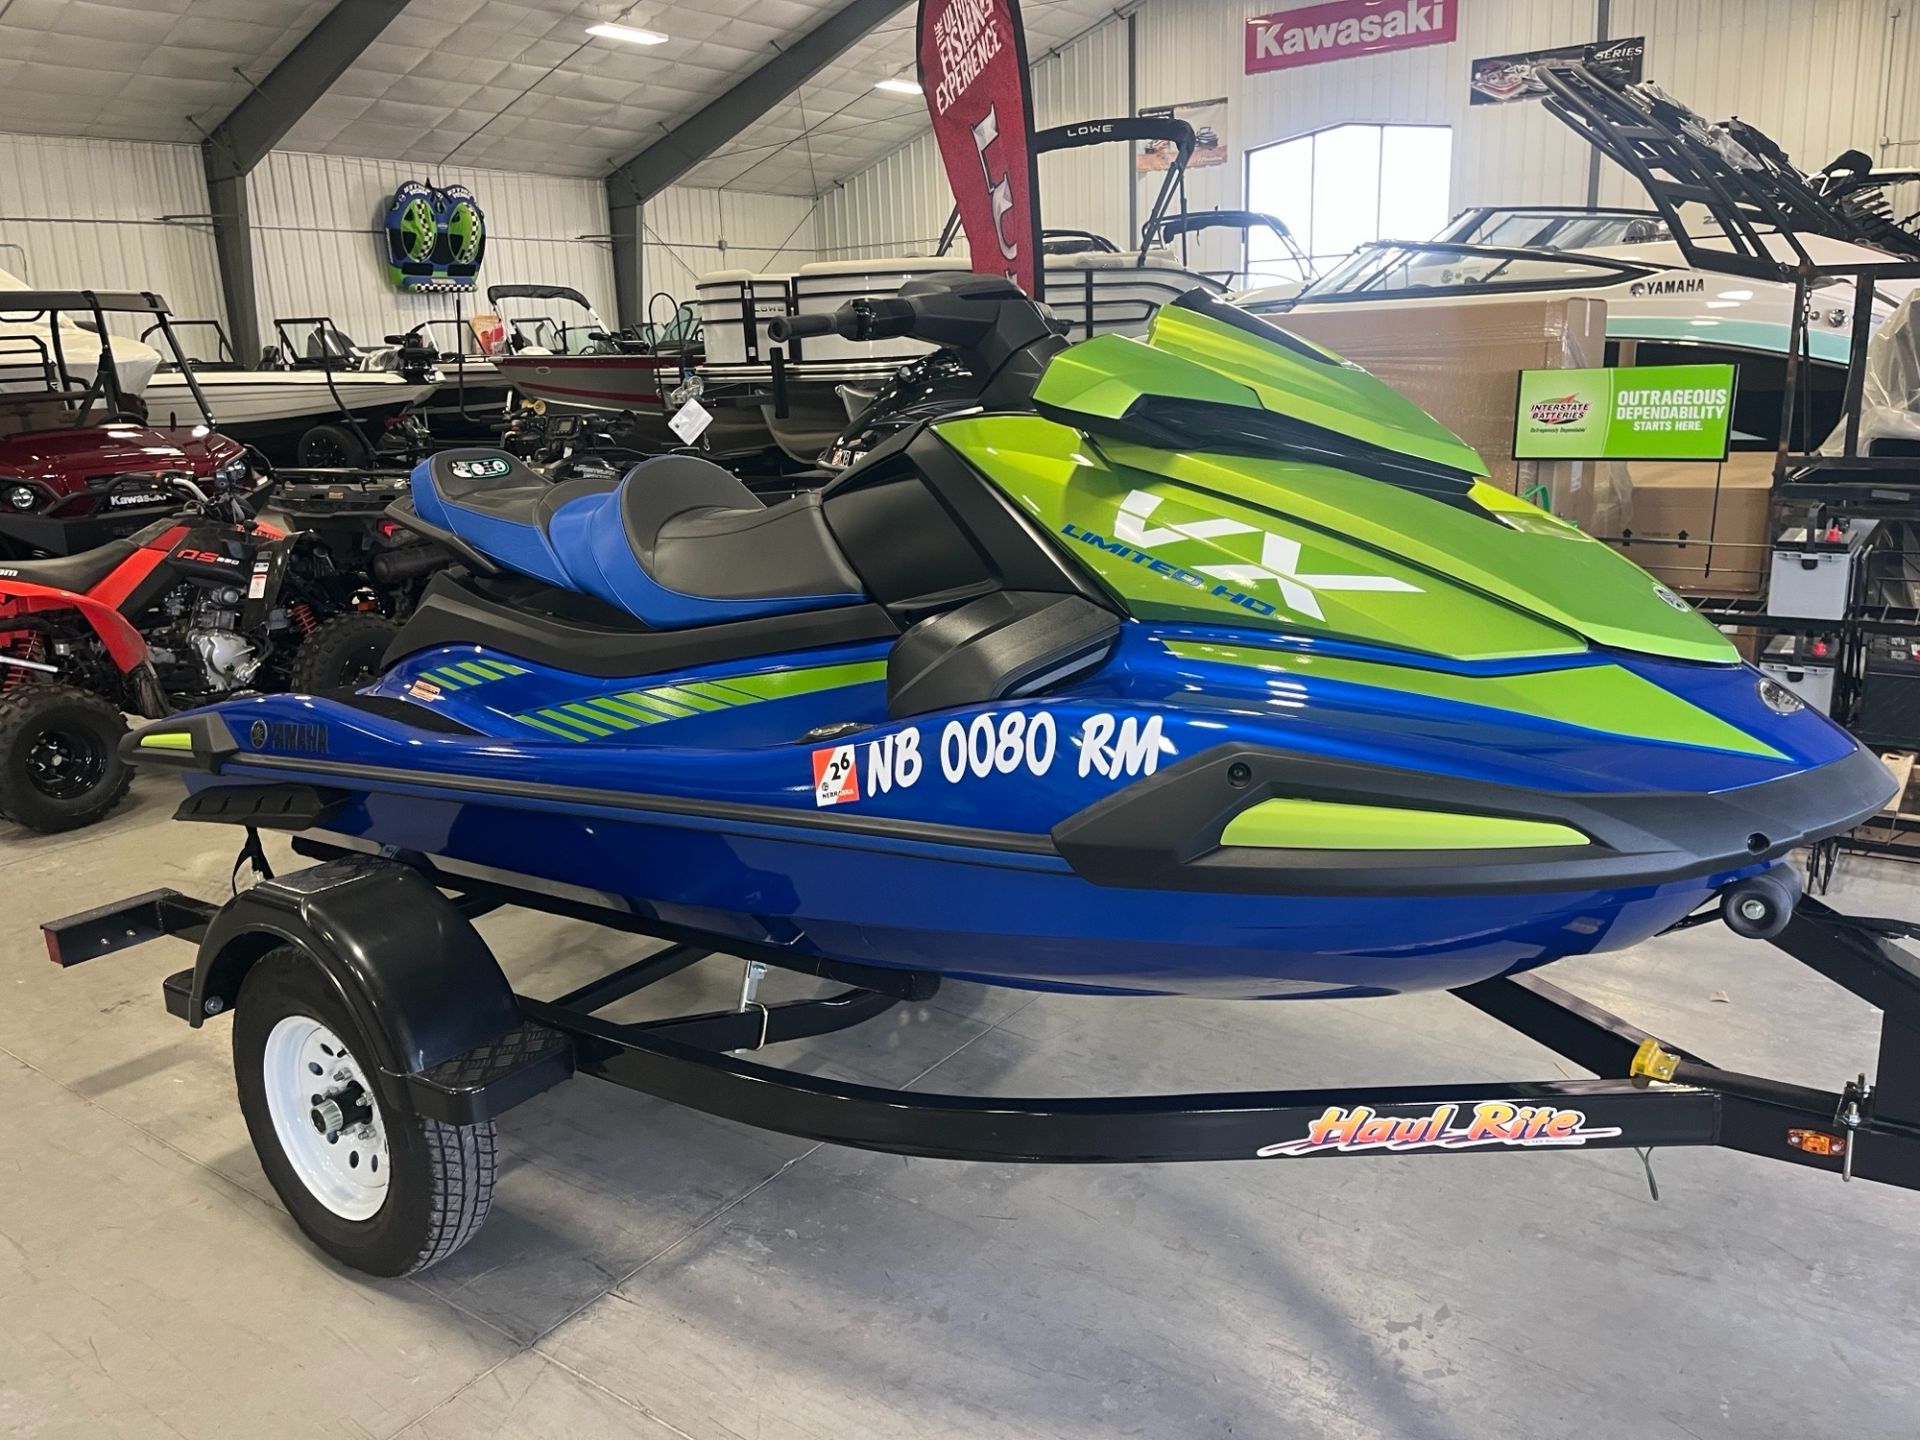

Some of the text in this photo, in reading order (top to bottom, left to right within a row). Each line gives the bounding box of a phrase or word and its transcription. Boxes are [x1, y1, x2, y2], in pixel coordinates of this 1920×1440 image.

[939, 0, 994, 78] FISHING
[1256, 0, 1444, 59] Kawasaki
[936, 19, 1002, 116] EXPERIENCE
[1067, 124, 1113, 137] LOWE
[1647, 279, 1705, 295] YAMAHA
[1617, 389, 1727, 406] OUTRAGEOUS
[1532, 411, 1584, 419] BATTERIES
[1616, 406, 1725, 420] DEPENDABILITY
[1633, 421, 1703, 431] STARTS HERE.
[1060, 523, 1275, 616] LIMITED HO
[1113, 489, 1426, 622] VX
[269, 722, 330, 753] YAMAHA
[830, 752, 850, 780] 26
[868, 711, 1164, 797] NB 0080 RM
[822, 788, 854, 799] NEBRASKA
[1310, 1102, 1583, 1146] Haul Rite
